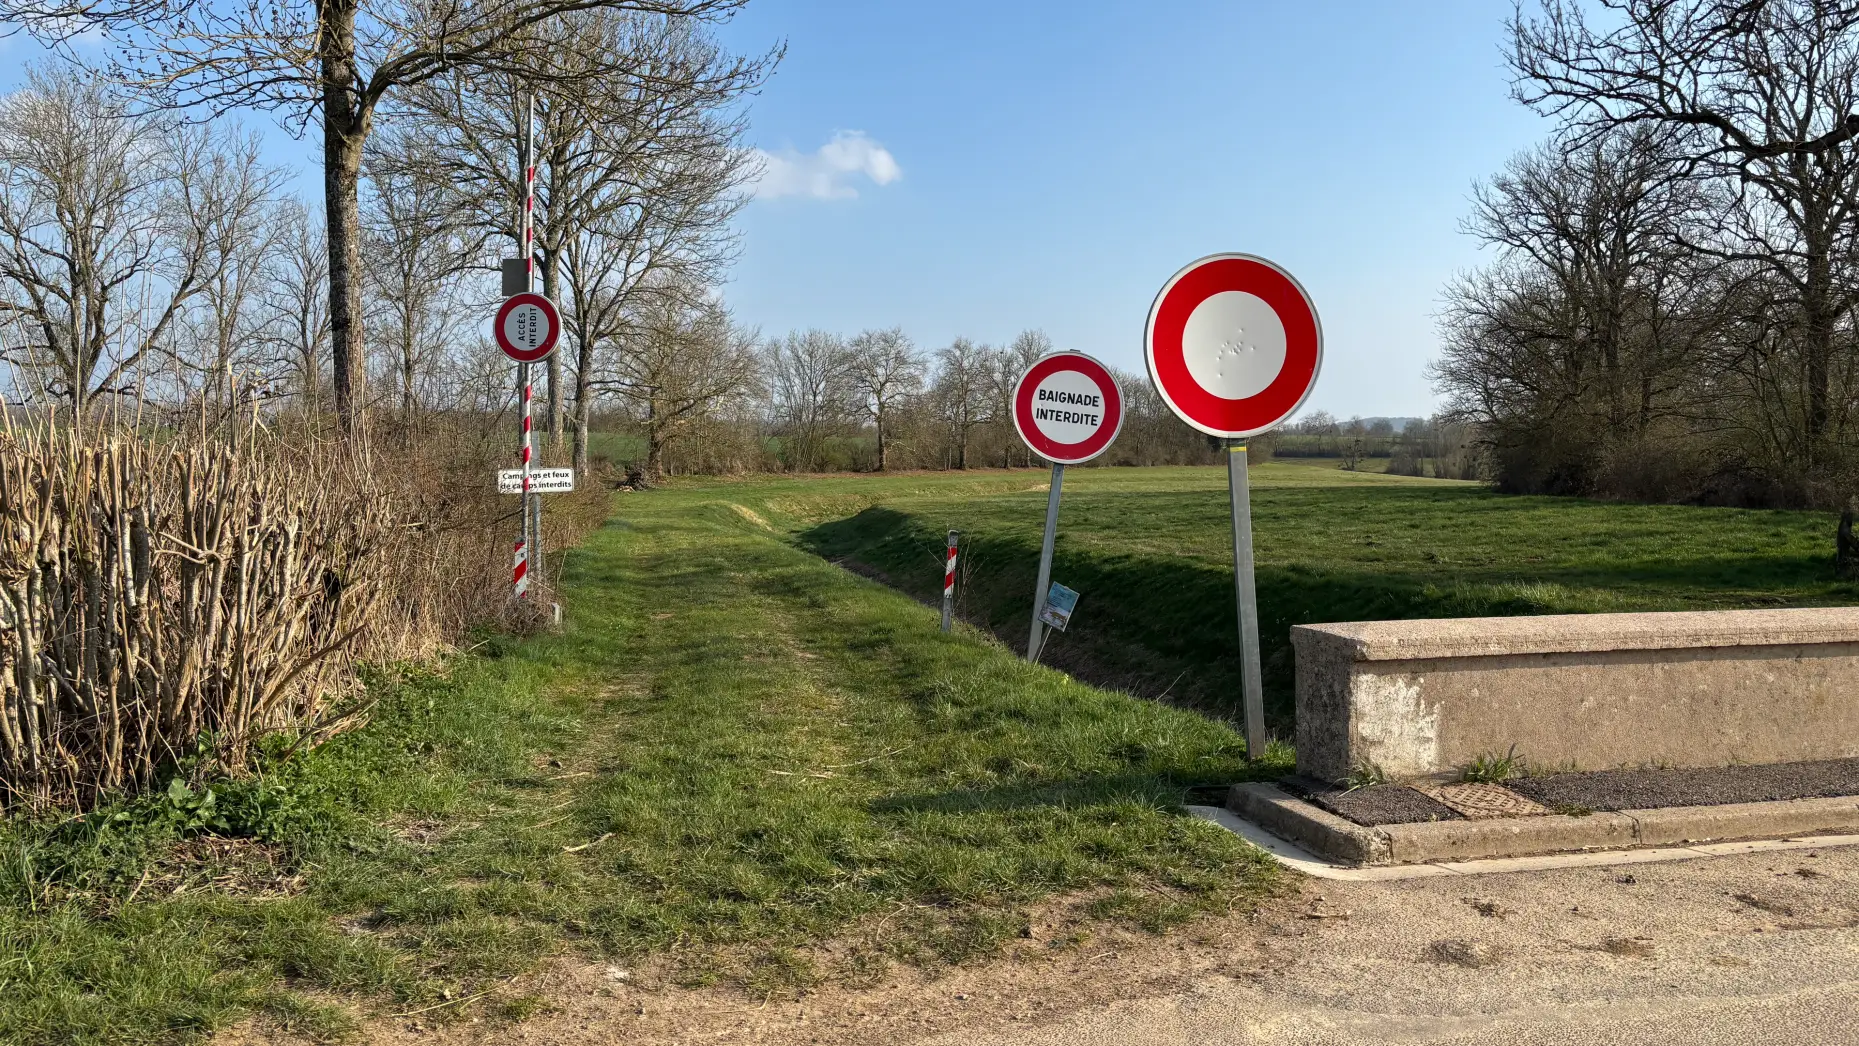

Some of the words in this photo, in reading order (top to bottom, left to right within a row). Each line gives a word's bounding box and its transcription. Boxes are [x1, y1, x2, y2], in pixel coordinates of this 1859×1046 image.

[517, 312, 526, 341] ACCÈS
[528, 307, 537, 347] INTERDIT
[1039, 389, 1100, 407] BAIGNADE
[1036, 408, 1098, 426] INTERDITE
[512, 483, 538, 491] caps
